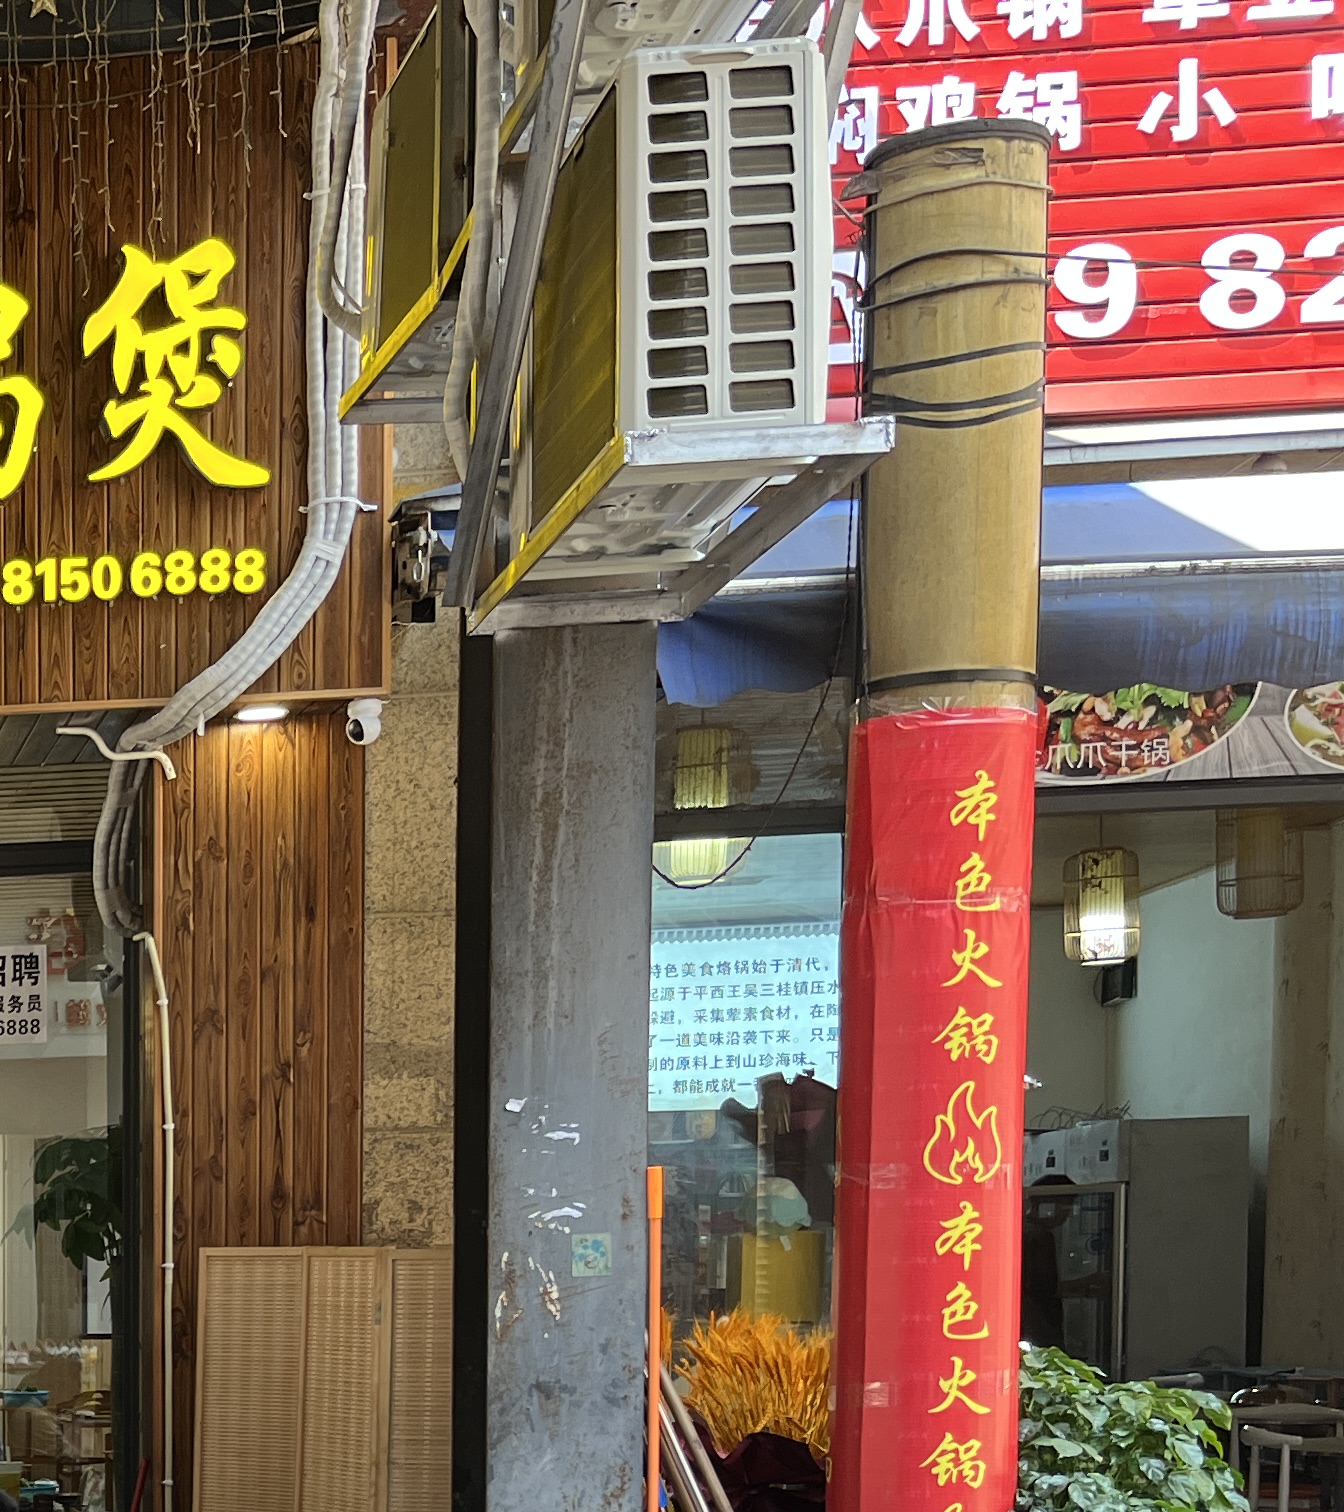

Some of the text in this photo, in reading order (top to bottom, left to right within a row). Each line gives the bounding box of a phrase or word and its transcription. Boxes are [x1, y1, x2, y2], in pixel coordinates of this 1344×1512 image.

[1034, 737, 1171, 771] 爪爪干锅
[932, 770, 1003, 1066] 本色火锅
[919, 1201, 992, 1490] 本色火锅
